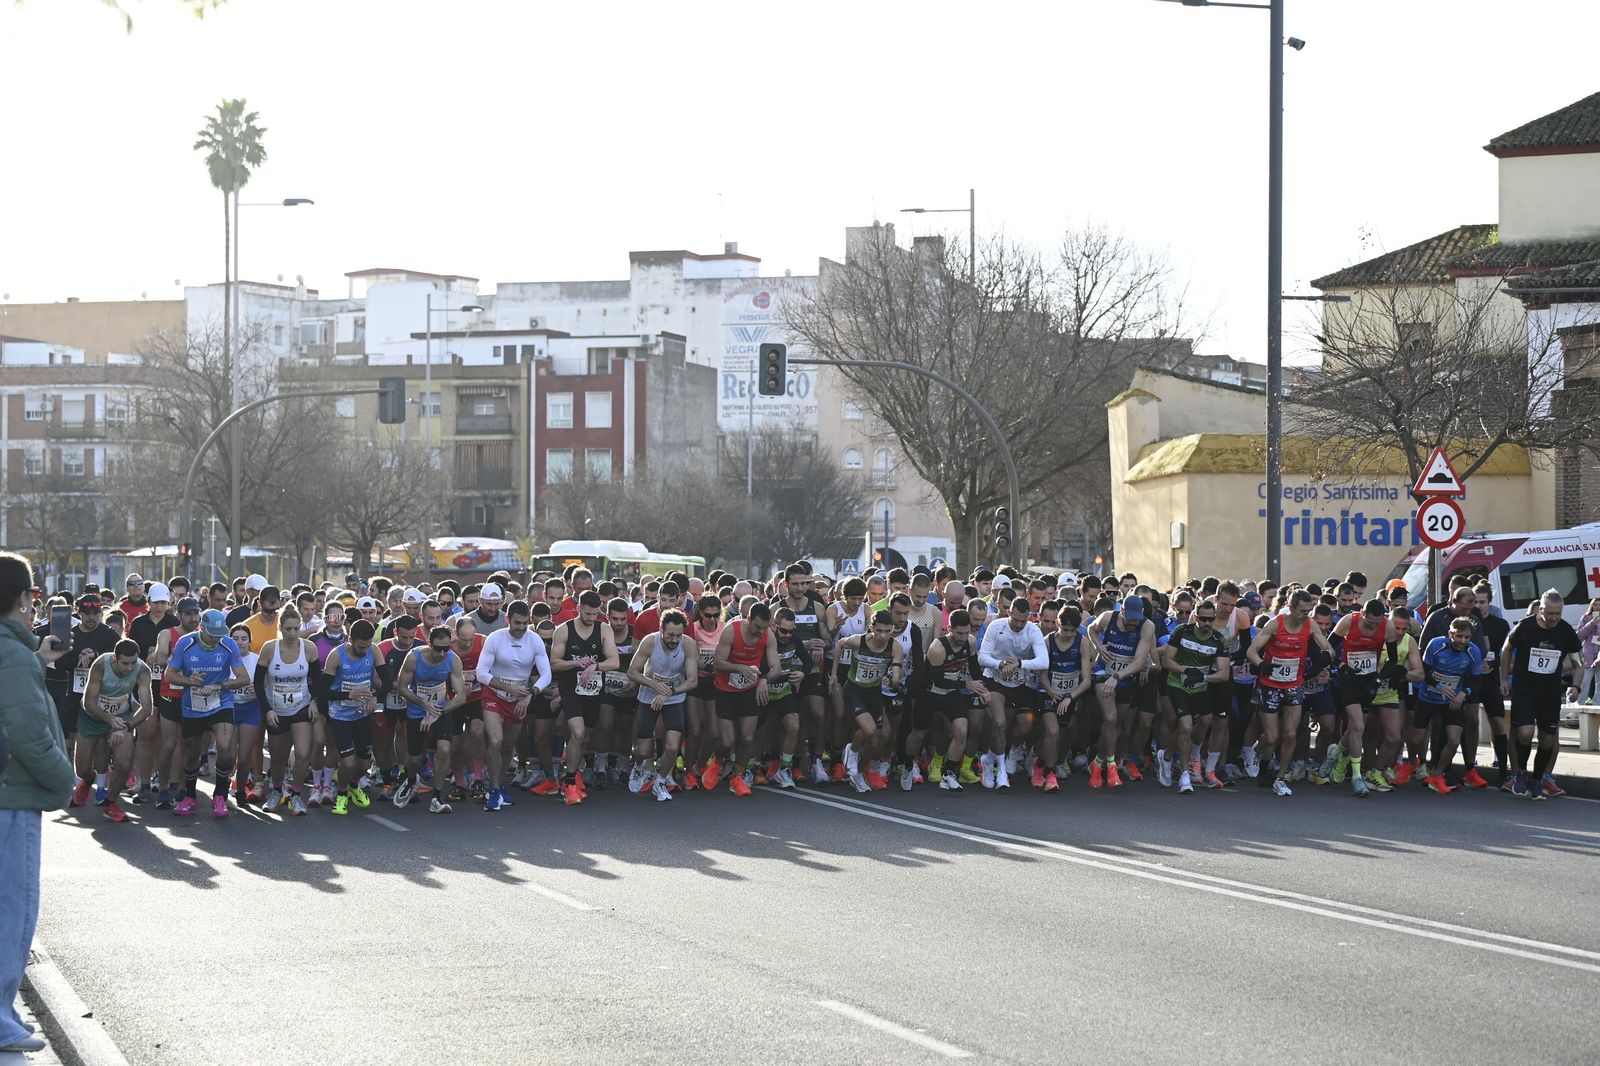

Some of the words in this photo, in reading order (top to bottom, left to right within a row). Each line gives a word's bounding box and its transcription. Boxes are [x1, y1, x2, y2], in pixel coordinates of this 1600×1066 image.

[1258, 484, 1318, 503] Cegio
[1323, 484, 1398, 500] Santísima
[1259, 509, 1422, 545] rinitari
[1427, 515, 1453, 531] 20
[1523, 544, 1582, 556] AMBULANCIA
[1353, 659, 1371, 670] 240
[1537, 658, 1550, 668] 87
[862, 670, 879, 679] 351
[1279, 666, 1291, 676] 49
[1057, 680, 1074, 690] 430
[283, 693, 294, 704] 14
[426, 692, 438, 702] 74
[103, 704, 121, 714] 203
